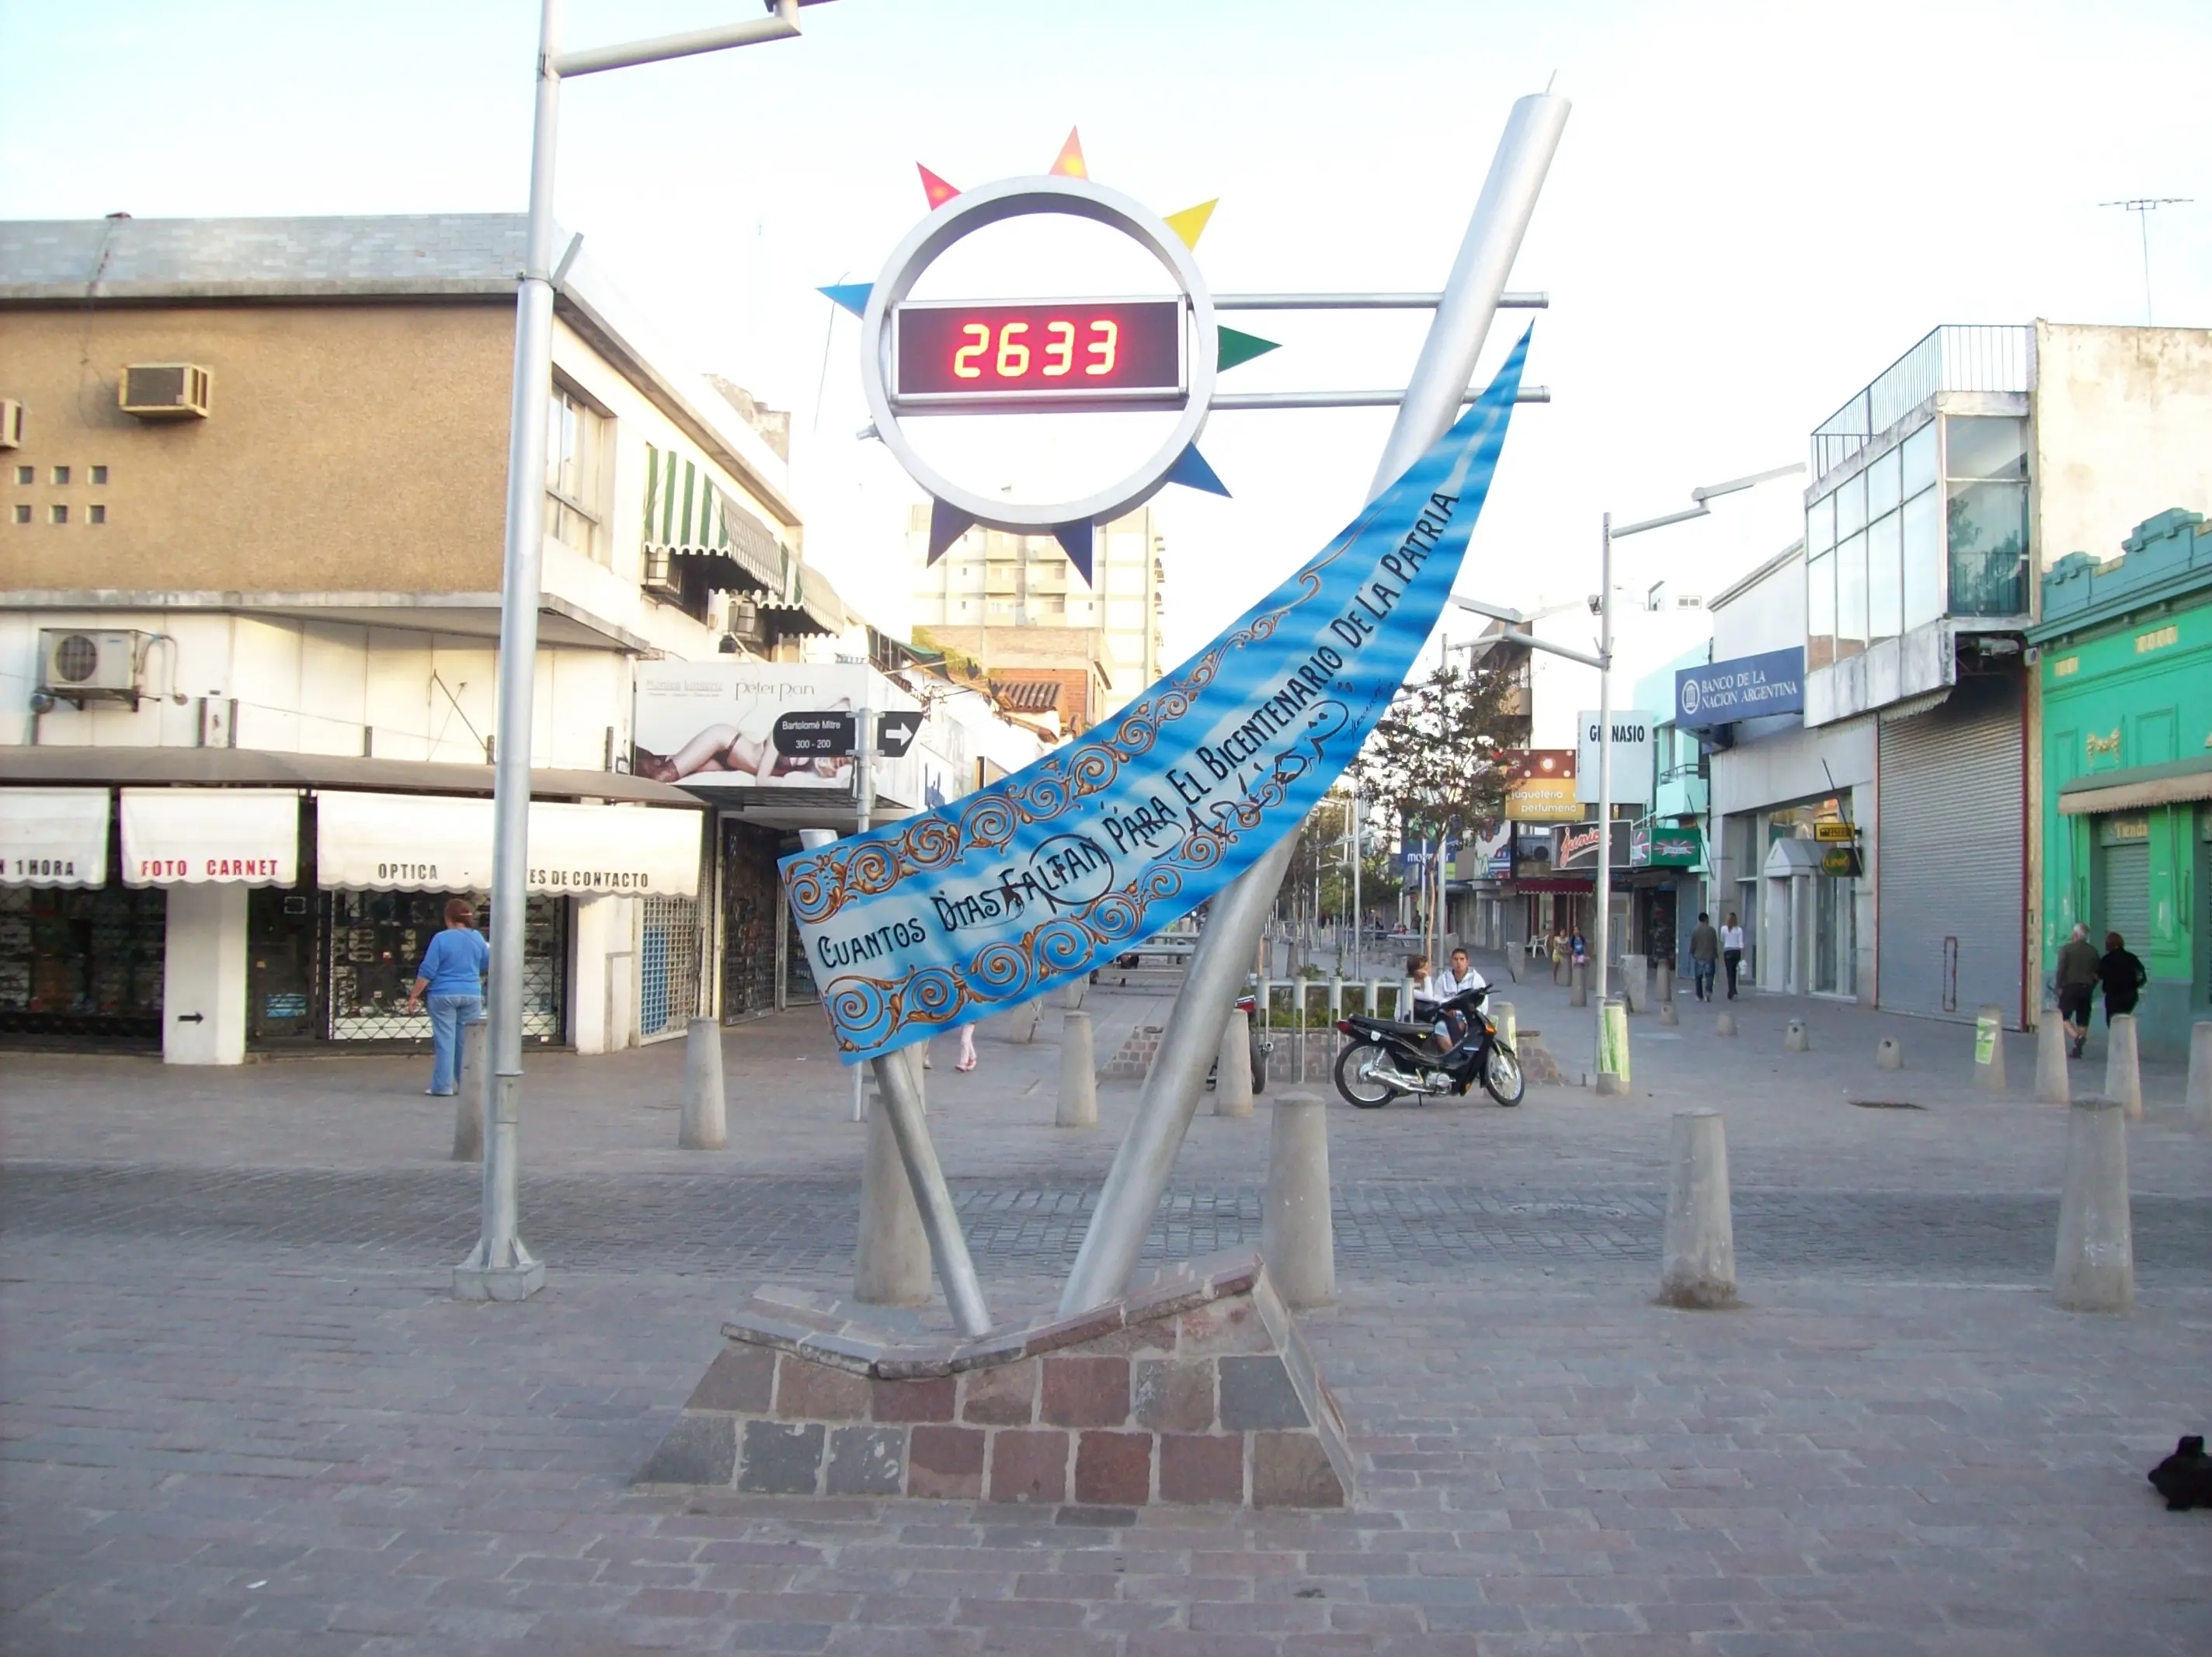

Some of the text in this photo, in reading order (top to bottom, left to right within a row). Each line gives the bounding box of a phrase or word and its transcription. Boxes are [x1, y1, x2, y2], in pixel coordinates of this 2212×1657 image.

[954, 320, 1118, 378] 2633
[1702, 670, 1766, 693] BANCO DE LA
[1702, 681, 1798, 709] NACION ARGENTINA
[782, 721, 841, 730] Bartolomé Mitre
[818, 918, 927, 968] CUANTOS
[997, 837, 1108, 910] FALTAN
[1102, 796, 1177, 855] PARA
[1166, 769, 1212, 805] EL
[1195, 645, 1343, 781] BICENTENARIO
[1330, 610, 1374, 649] DE
[1355, 582, 1401, 621] LA
[1380, 492, 1460, 585] PATRIA
[1590, 725, 1645, 742] GINASIO
[795, 739, 810, 749] 300
[816, 739, 831, 749] 200
[1560, 827, 1612, 868] junio
[141, 859, 279, 877] FOTO CARNET
[378, 863, 438, 880] OPTICA
[551, 870, 568, 885] DE
[572, 870, 649, 888] CONTACTO
